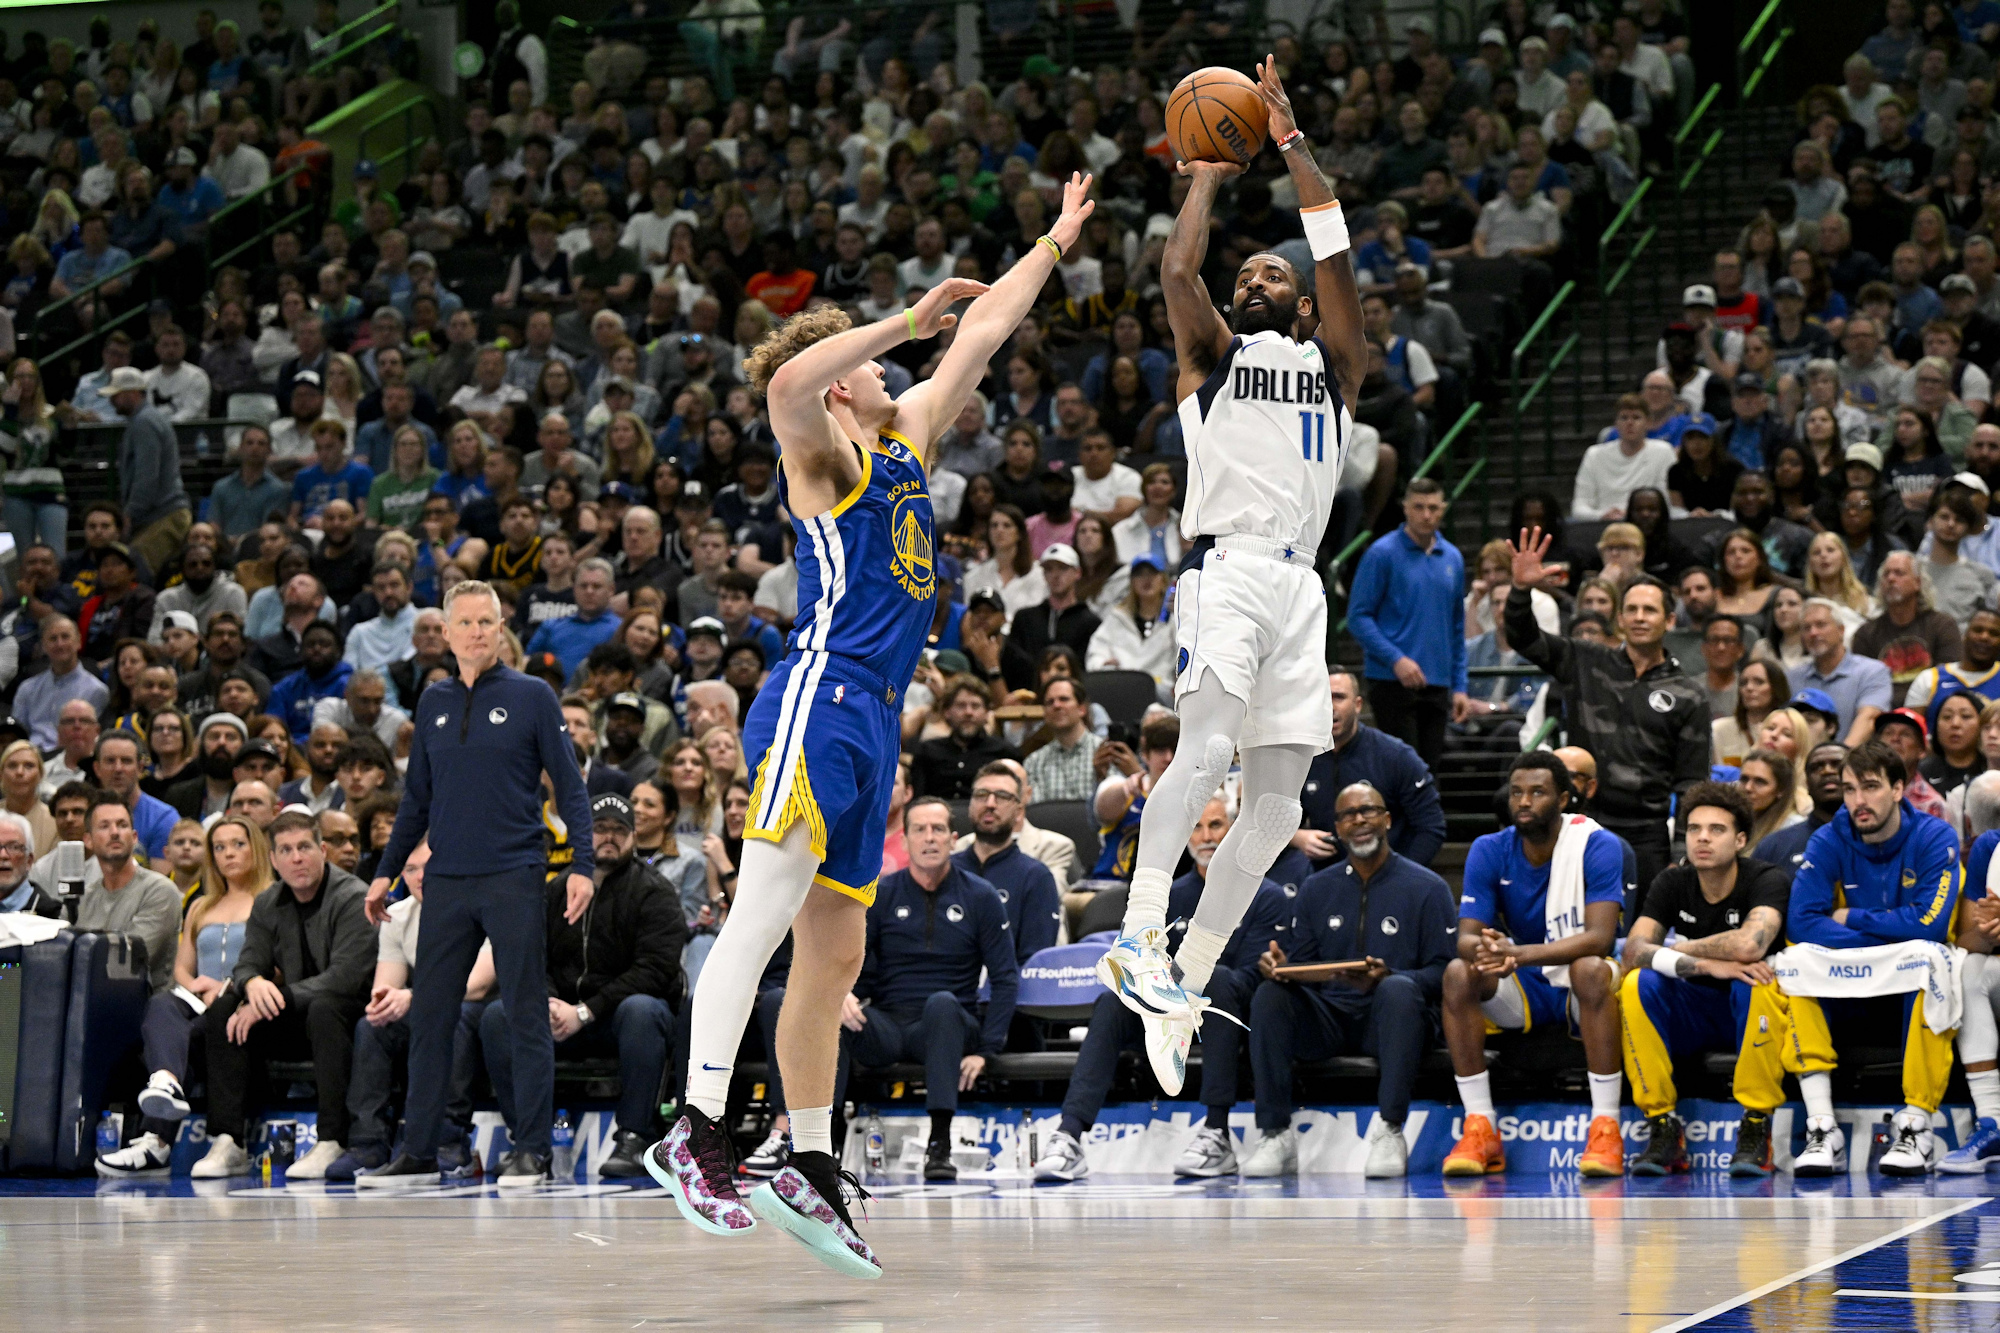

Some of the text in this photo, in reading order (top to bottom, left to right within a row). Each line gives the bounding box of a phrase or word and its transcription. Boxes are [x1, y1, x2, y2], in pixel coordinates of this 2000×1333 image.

[1233, 366, 1325, 405] DALLAS
[1298, 410, 1325, 464] 11
[1919, 869, 1952, 926] WARRIORS
[1828, 965, 1872, 979] UTSW
